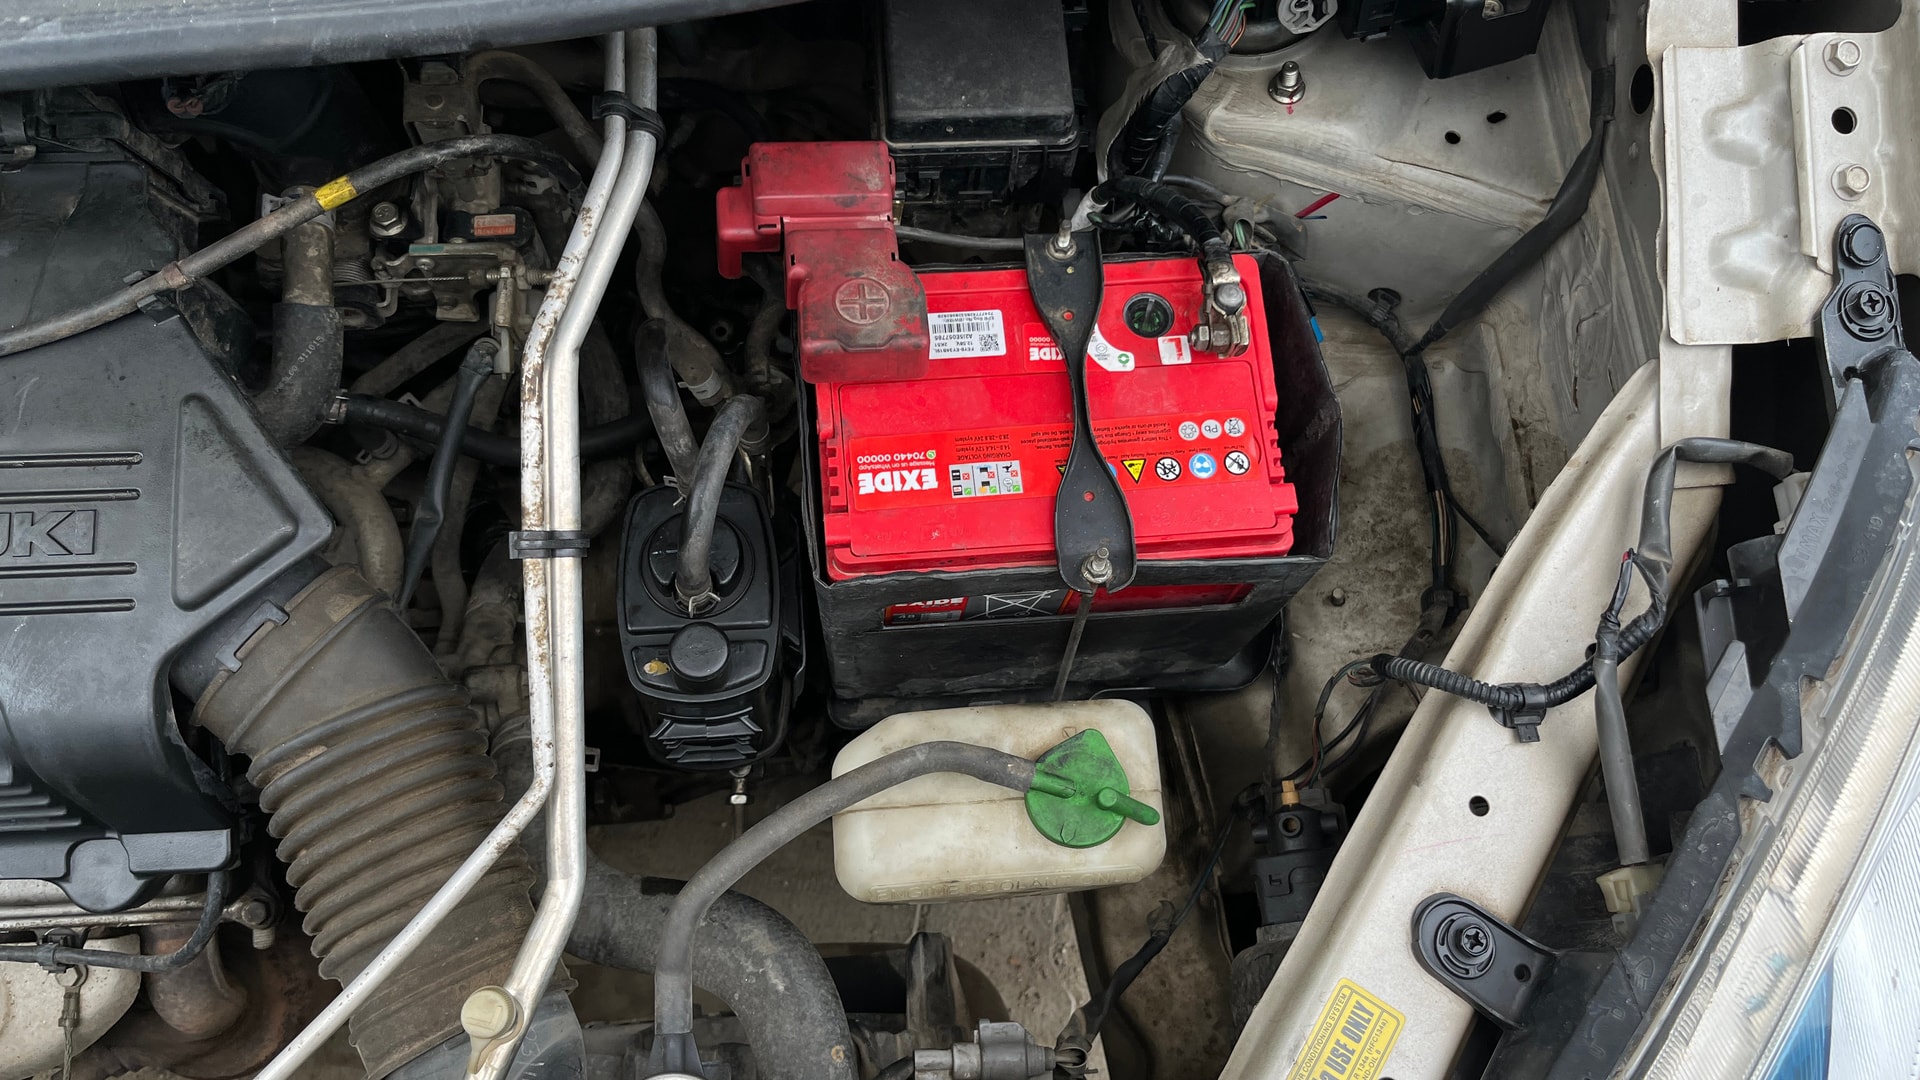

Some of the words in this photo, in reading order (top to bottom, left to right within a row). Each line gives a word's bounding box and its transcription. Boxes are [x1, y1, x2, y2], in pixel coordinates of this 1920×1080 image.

[1162, 338, 1184, 361] L
[1204, 424, 1218, 434] Pb
[856, 454, 891, 464] 00000
[858, 463, 890, 471] WhatsApp
[893, 452, 925, 461] 70440
[909, 460, 935, 468] Message
[958, 453, 981, 461] VOLTAGE
[858, 468, 938, 495] EXIDE
[0, 510, 97, 558] KI
[1784, 511, 1829, 571] UMAX
[876, 885, 959, 901] ENGINE
[964, 874, 1072, 894] COOLANT
[1302, 1022, 1333, 1073] CONDITIONING
[1329, 993, 1347, 1022] SYSTEM
[1324, 1039, 1356, 1076] USE
[1341, 1000, 1374, 1044] ONLY
